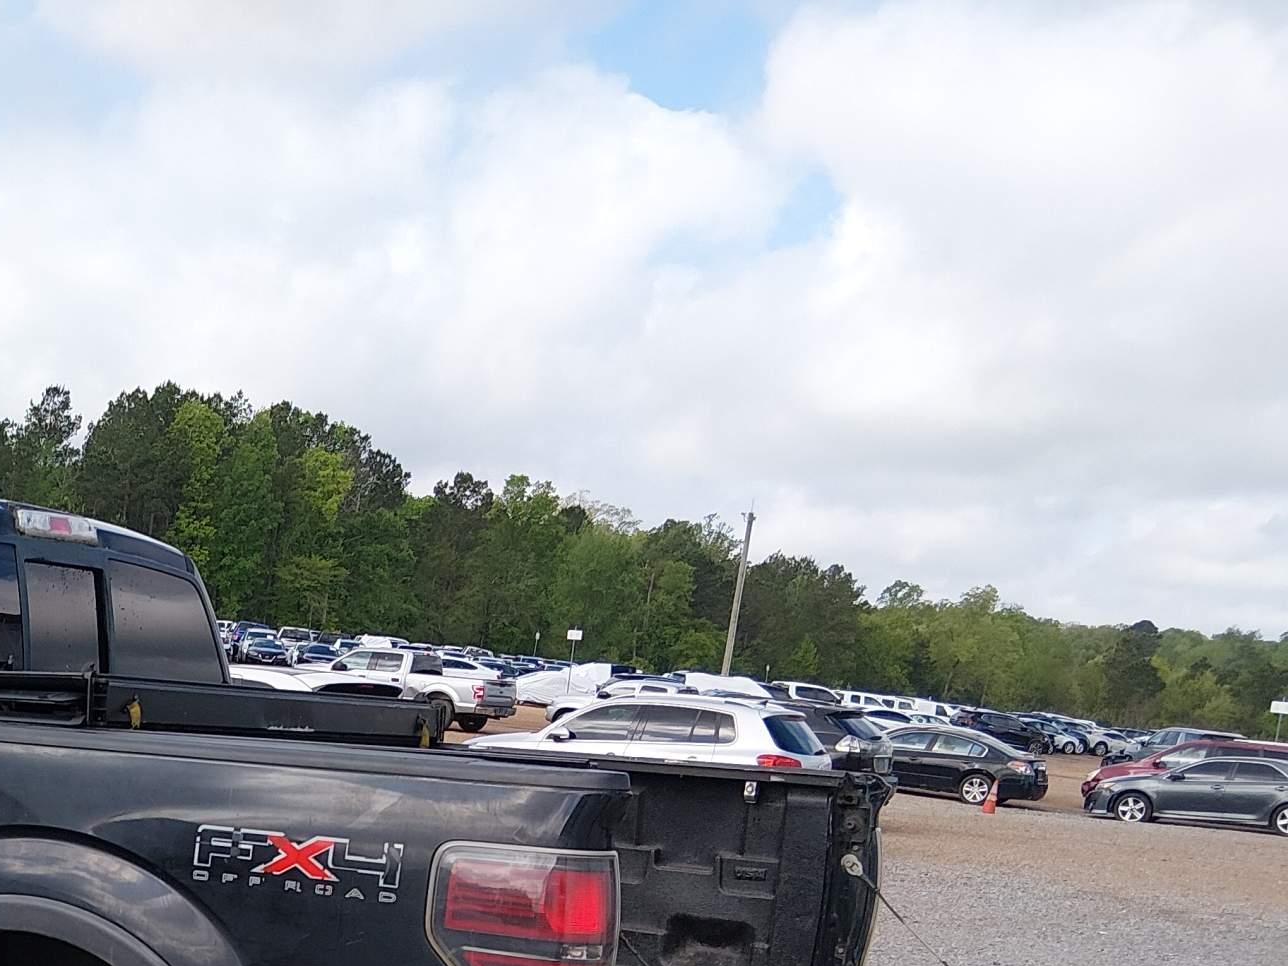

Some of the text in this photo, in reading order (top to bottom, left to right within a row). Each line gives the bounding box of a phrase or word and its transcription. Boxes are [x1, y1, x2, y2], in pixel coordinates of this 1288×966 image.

[192, 824, 405, 889] FX4
[192, 869, 398, 904] OFF ROAD
